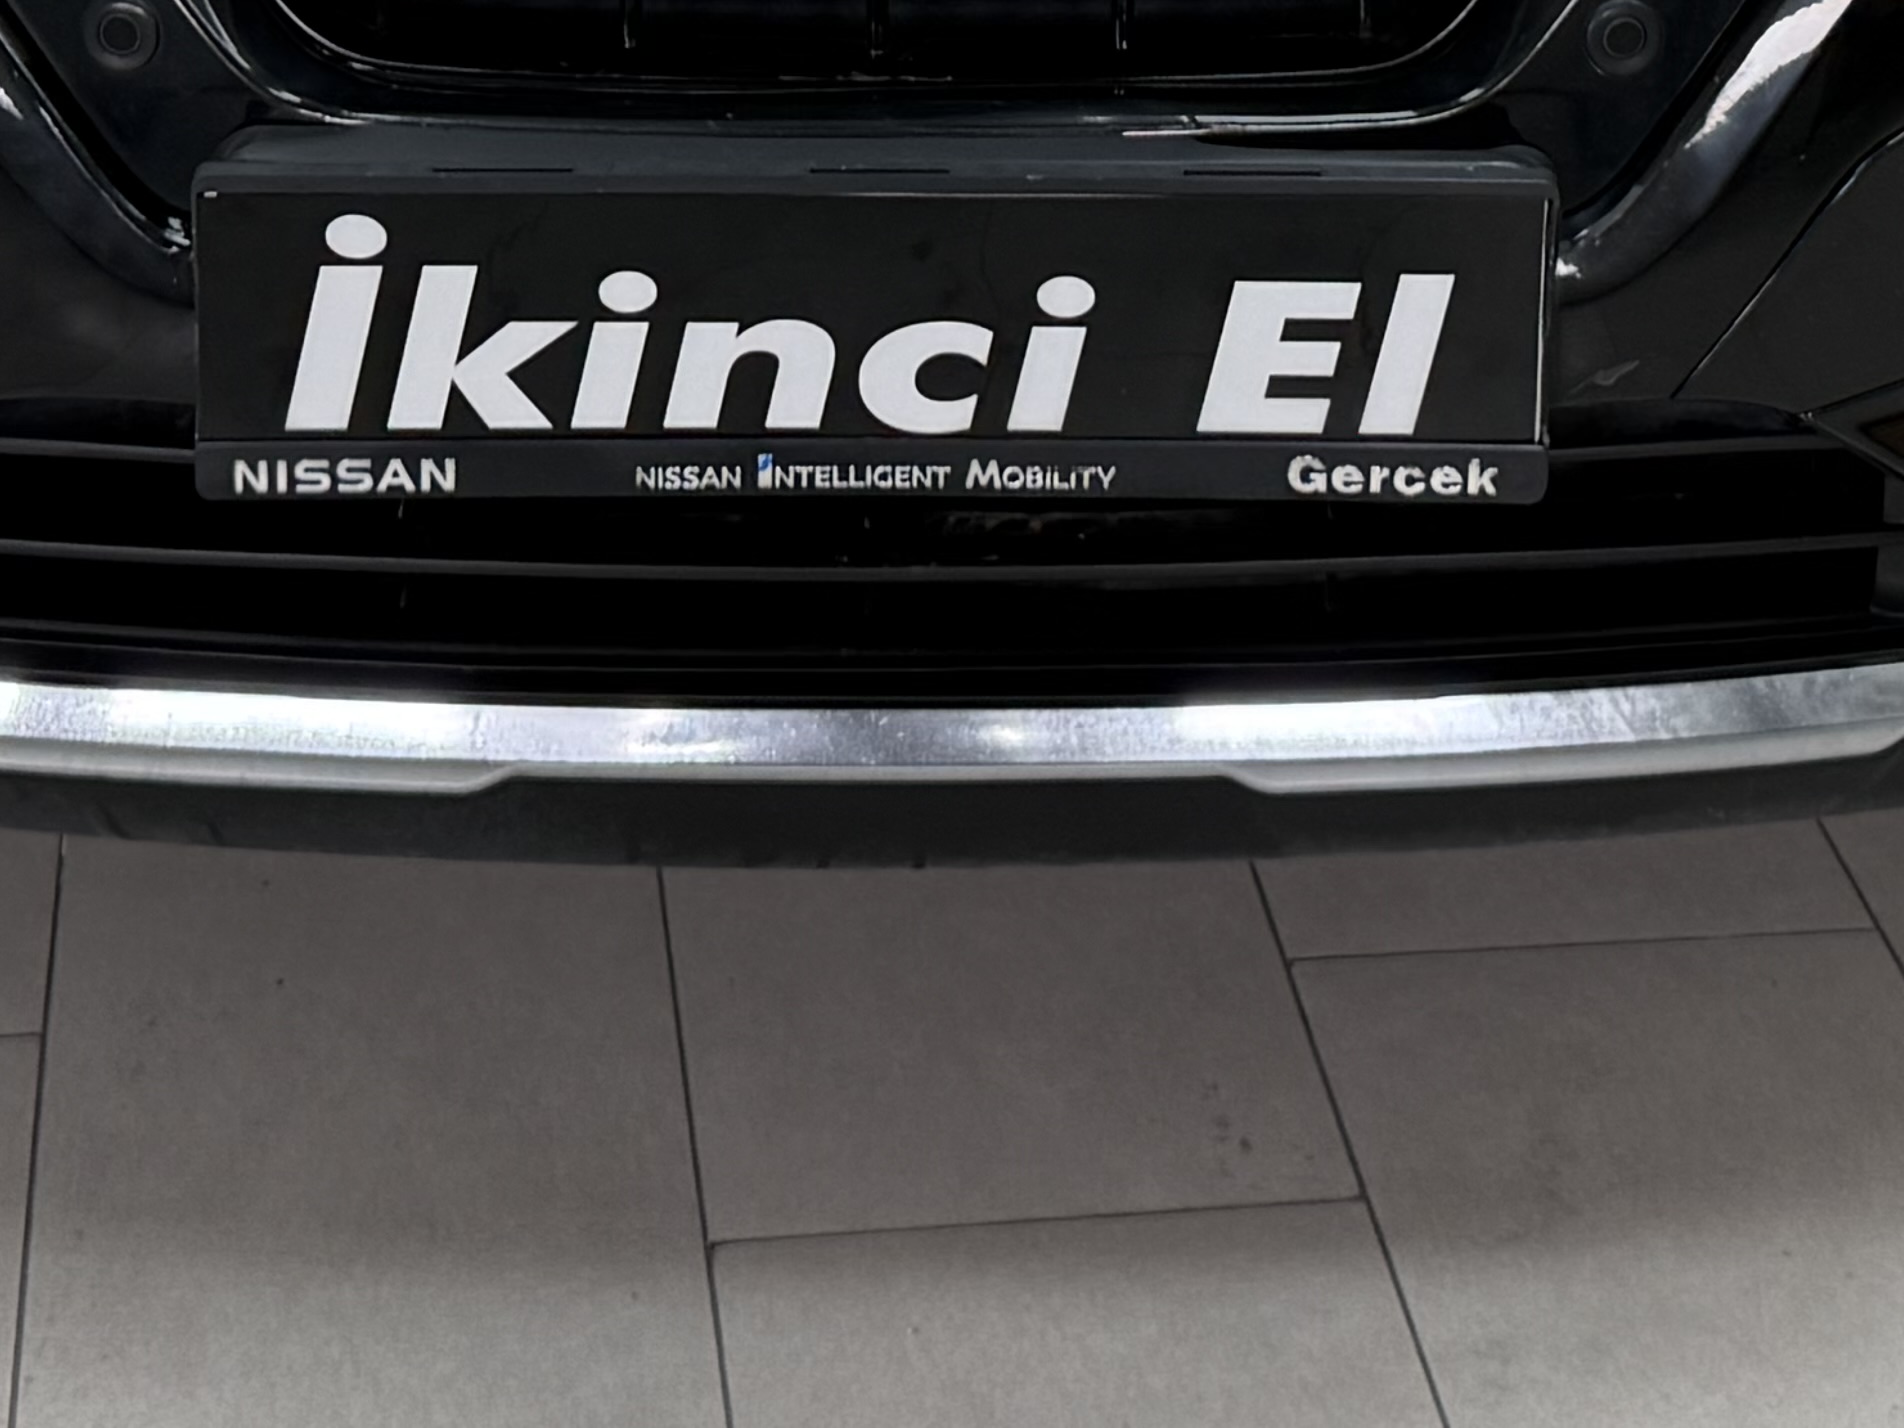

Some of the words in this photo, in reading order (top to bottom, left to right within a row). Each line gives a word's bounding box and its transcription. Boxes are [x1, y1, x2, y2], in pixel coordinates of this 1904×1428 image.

[284, 213, 1095, 435] İkinci
[1196, 273, 1455, 435] El
[233, 458, 456, 495] NISSAN
[635, 464, 742, 490] NISSAN
[1287, 455, 1498, 496] Gercek
